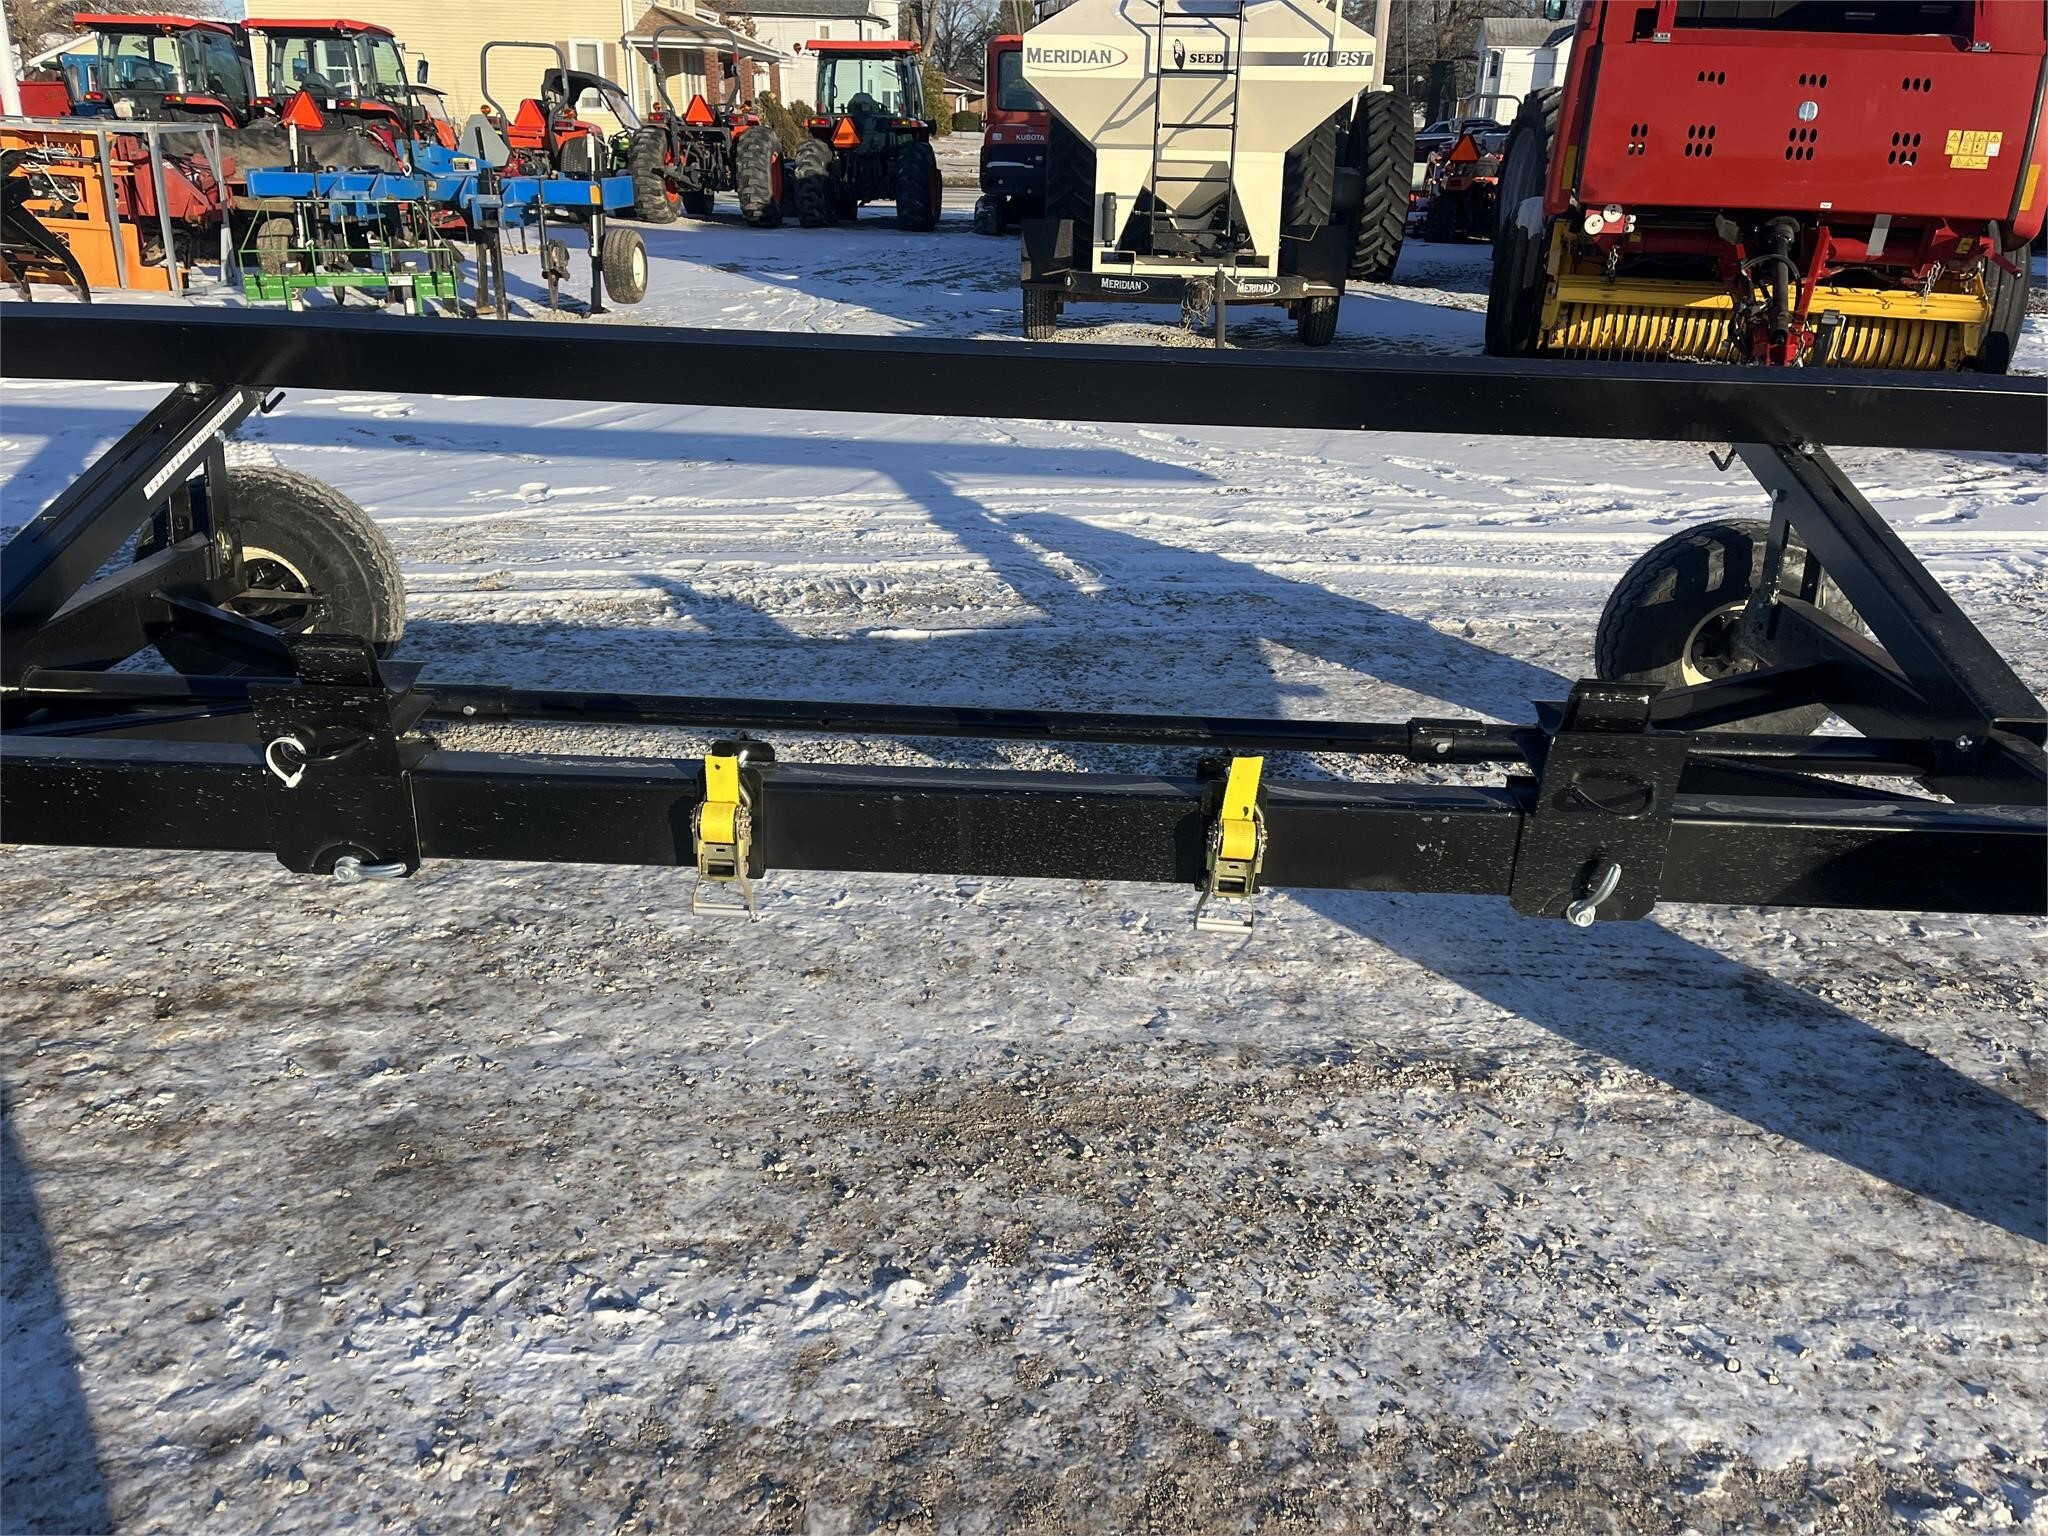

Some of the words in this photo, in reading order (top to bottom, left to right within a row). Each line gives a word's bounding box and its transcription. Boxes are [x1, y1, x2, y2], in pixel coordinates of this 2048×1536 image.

[1026, 47, 1112, 64] MERIDIAN
[1189, 53, 1224, 64] SEED
[1302, 52, 1329, 66] 110
[1337, 52, 1372, 66] BST
[1101, 277, 1142, 291] MERIDIAN
[1236, 282, 1275, 293] MERIDIAN
